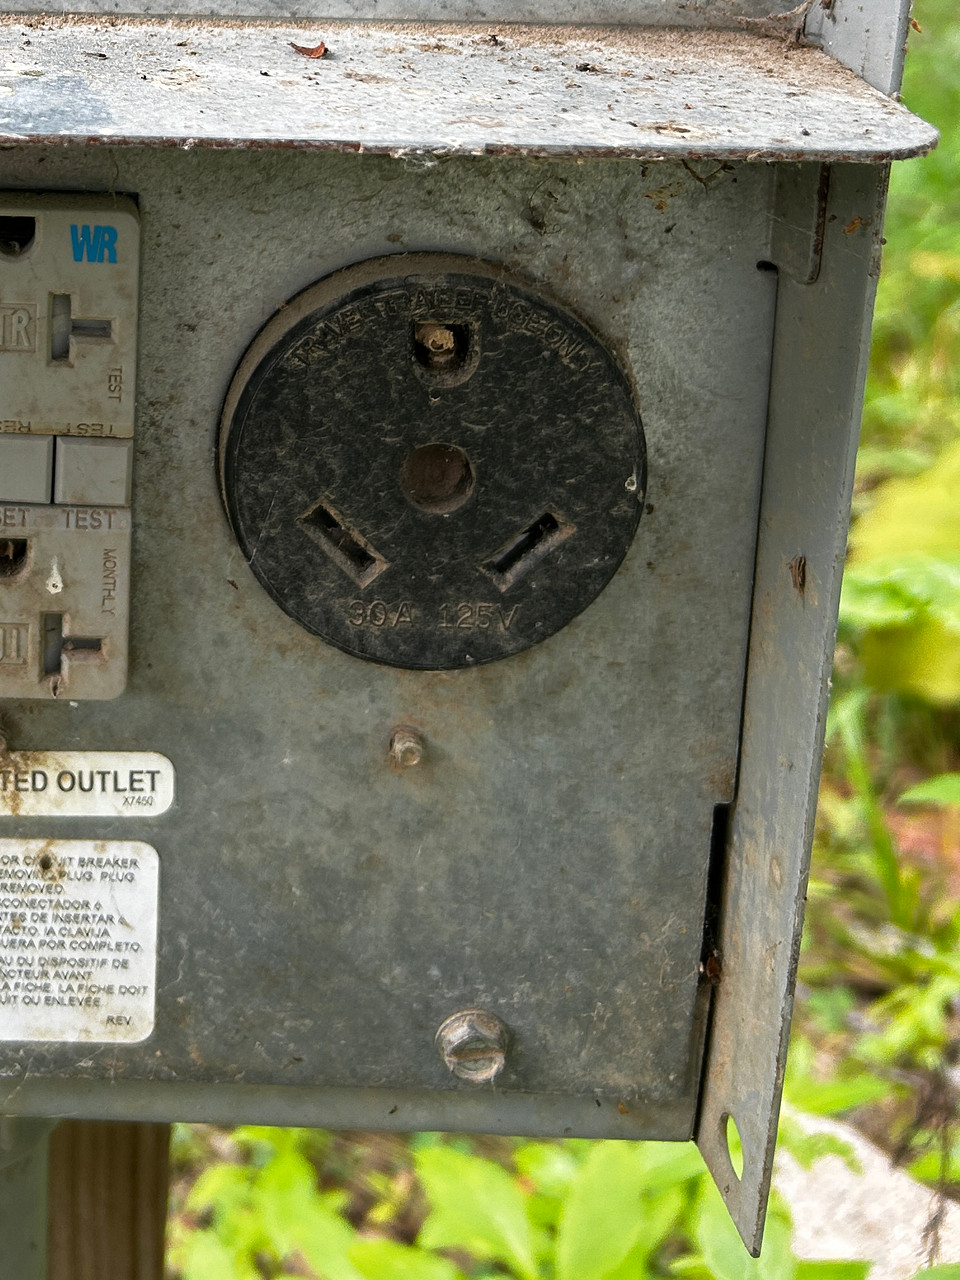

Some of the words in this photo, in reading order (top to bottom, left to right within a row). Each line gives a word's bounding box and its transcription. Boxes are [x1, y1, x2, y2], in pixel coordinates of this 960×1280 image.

[71, 224, 118, 264] WR
[108, 365, 123, 403] TEST
[62, 509, 117, 530] TEST
[101, 548, 117, 617] MONTHLY
[348, 600, 416, 629] 30A
[438, 604, 520, 632] 125V
[57, 770, 160, 792] OUTLET
